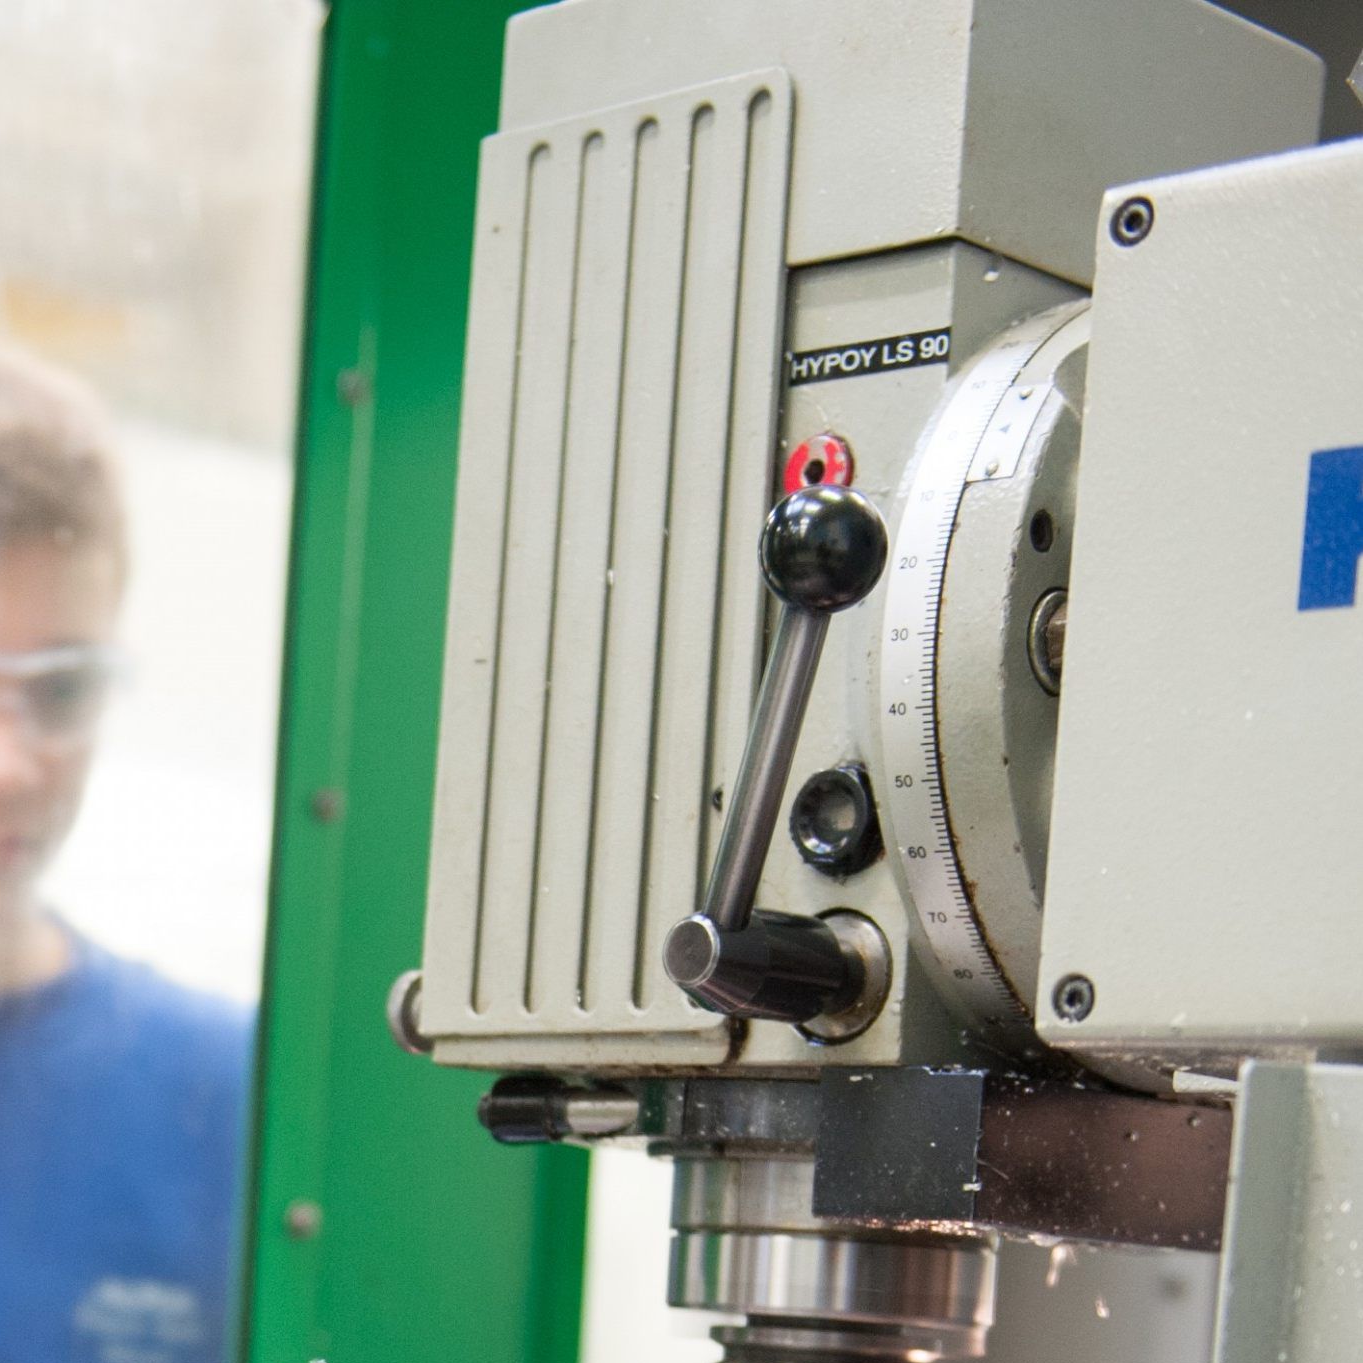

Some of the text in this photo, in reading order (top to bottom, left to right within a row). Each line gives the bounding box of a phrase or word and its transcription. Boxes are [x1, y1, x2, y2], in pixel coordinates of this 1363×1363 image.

[791, 334, 949, 379] HYPOY LS 90
[899, 555, 918, 570] 20
[890, 627, 909, 641] 30
[888, 702, 907, 716] 40
[894, 774, 913, 788] 50
[907, 846, 927, 859] 60
[927, 911, 947, 924] 70
[953, 968, 973, 980] 80
